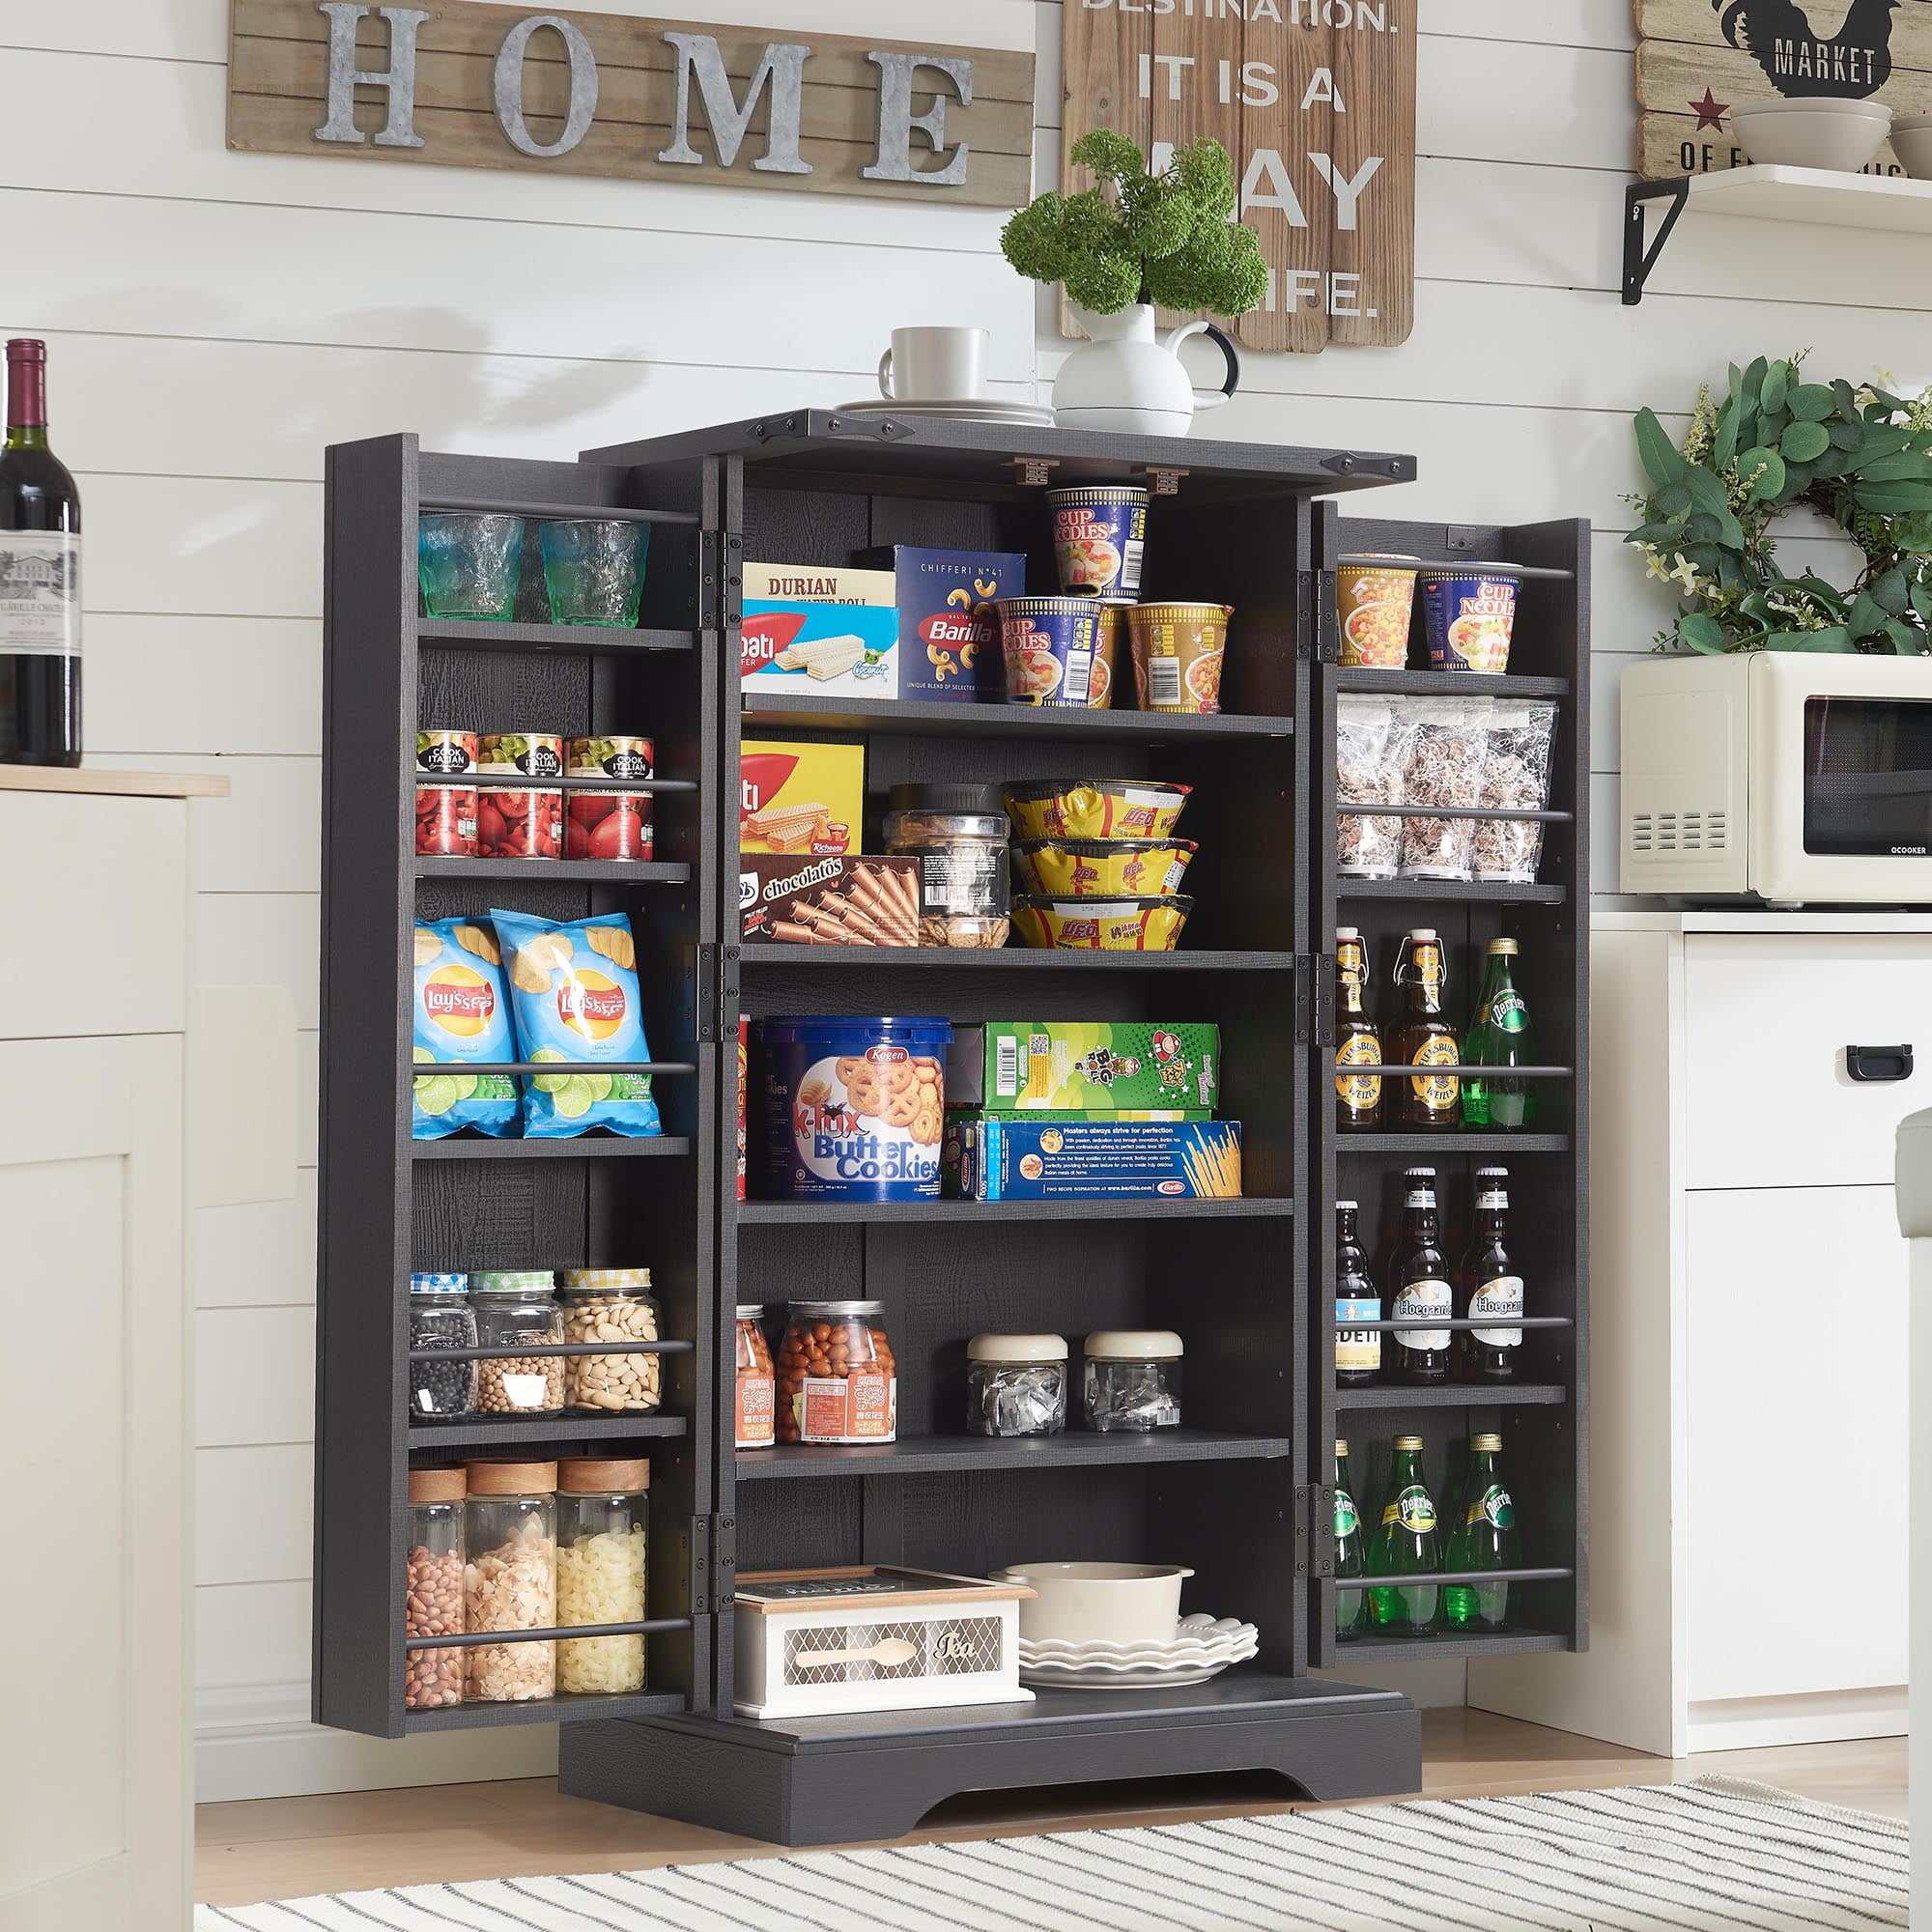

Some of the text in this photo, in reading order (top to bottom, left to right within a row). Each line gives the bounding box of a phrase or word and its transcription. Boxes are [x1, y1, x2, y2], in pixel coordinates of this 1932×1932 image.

[1082, 0, 1398, 33] TINATION.
[1774, 38, 1875, 85] MARKET
[1138, 53, 1347, 113] IT IS A
[314, 1, 973, 185] HOME
[1680, 142, 1714, 172] OF
[1111, 142, 1385, 231] AY
[1254, 269, 1378, 318] IFE.
[1058, 510, 1094, 526] CUP
[1054, 524, 1110, 541] OODLES
[921, 563, 972, 575] CHIFFERI
[768, 578, 838, 595] DURIAN
[1479, 584, 1514, 600] CUP
[929, 621, 993, 642] Barilla
[1003, 619, 1035, 636] CUP
[428, 754, 465, 764] ITALIAN
[433, 748, 462, 756] COOK
[611, 762, 646, 772] ITALIAN
[740, 779, 758, 810] ti
[871, 1049, 903, 1061] Kogen
[1348, 1086, 1378, 1099] WEIZEN
[1426, 1086, 1455, 1100] WEIZEN
[814, 1135, 914, 1160] Butter
[837, 1154, 937, 1179] Cookies
[932, 1630, 976, 1660] Tea
